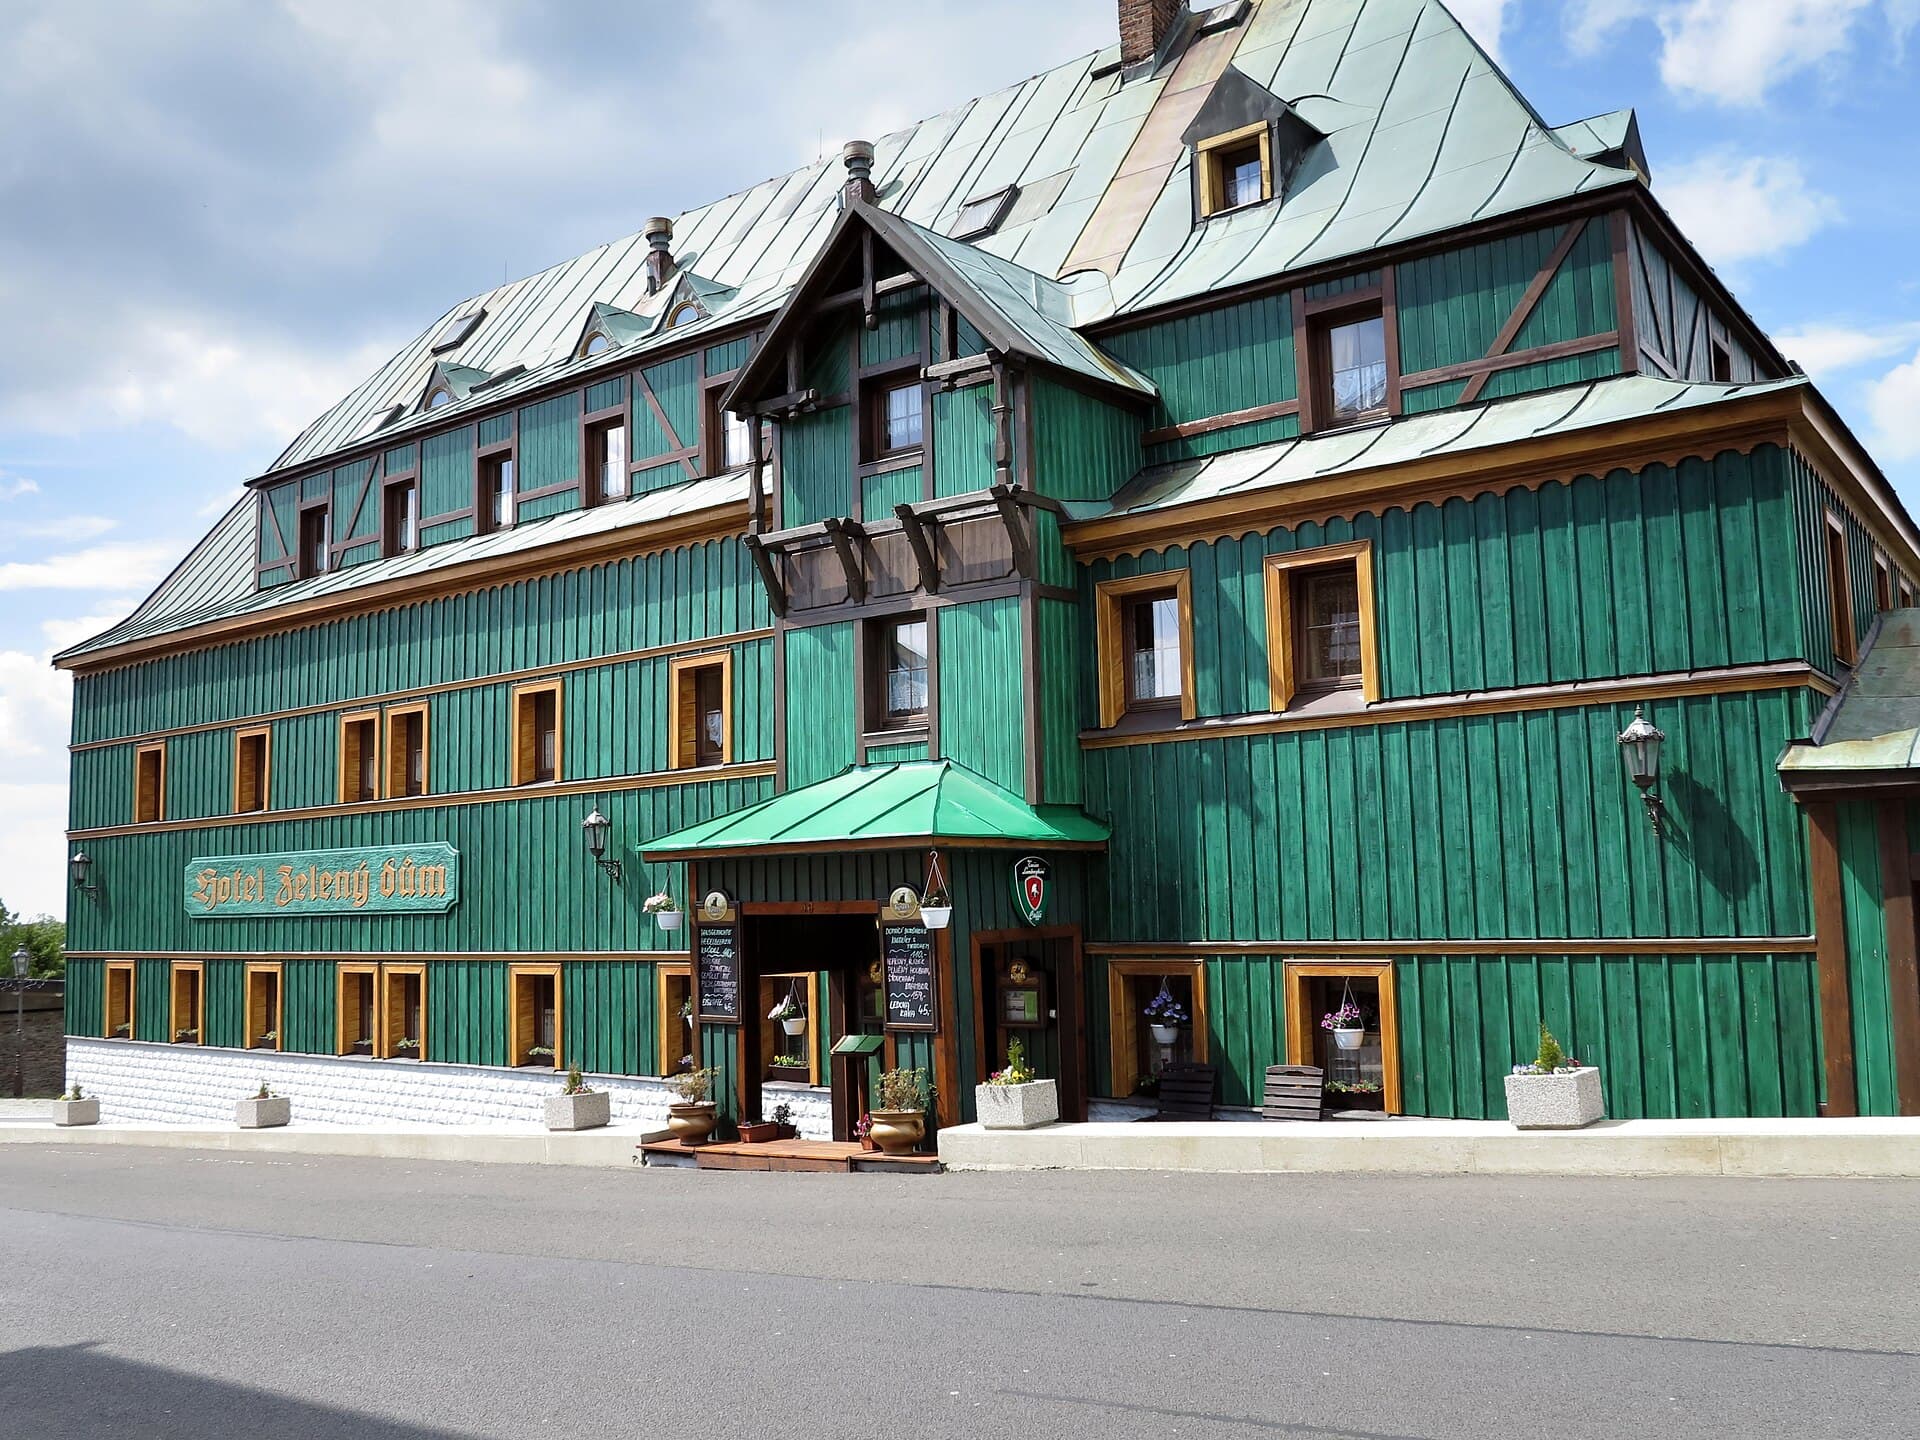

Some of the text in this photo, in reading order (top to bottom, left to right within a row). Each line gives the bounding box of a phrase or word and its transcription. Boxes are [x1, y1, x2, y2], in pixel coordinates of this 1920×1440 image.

[193, 855, 447, 910] Hotel Zelený dům
